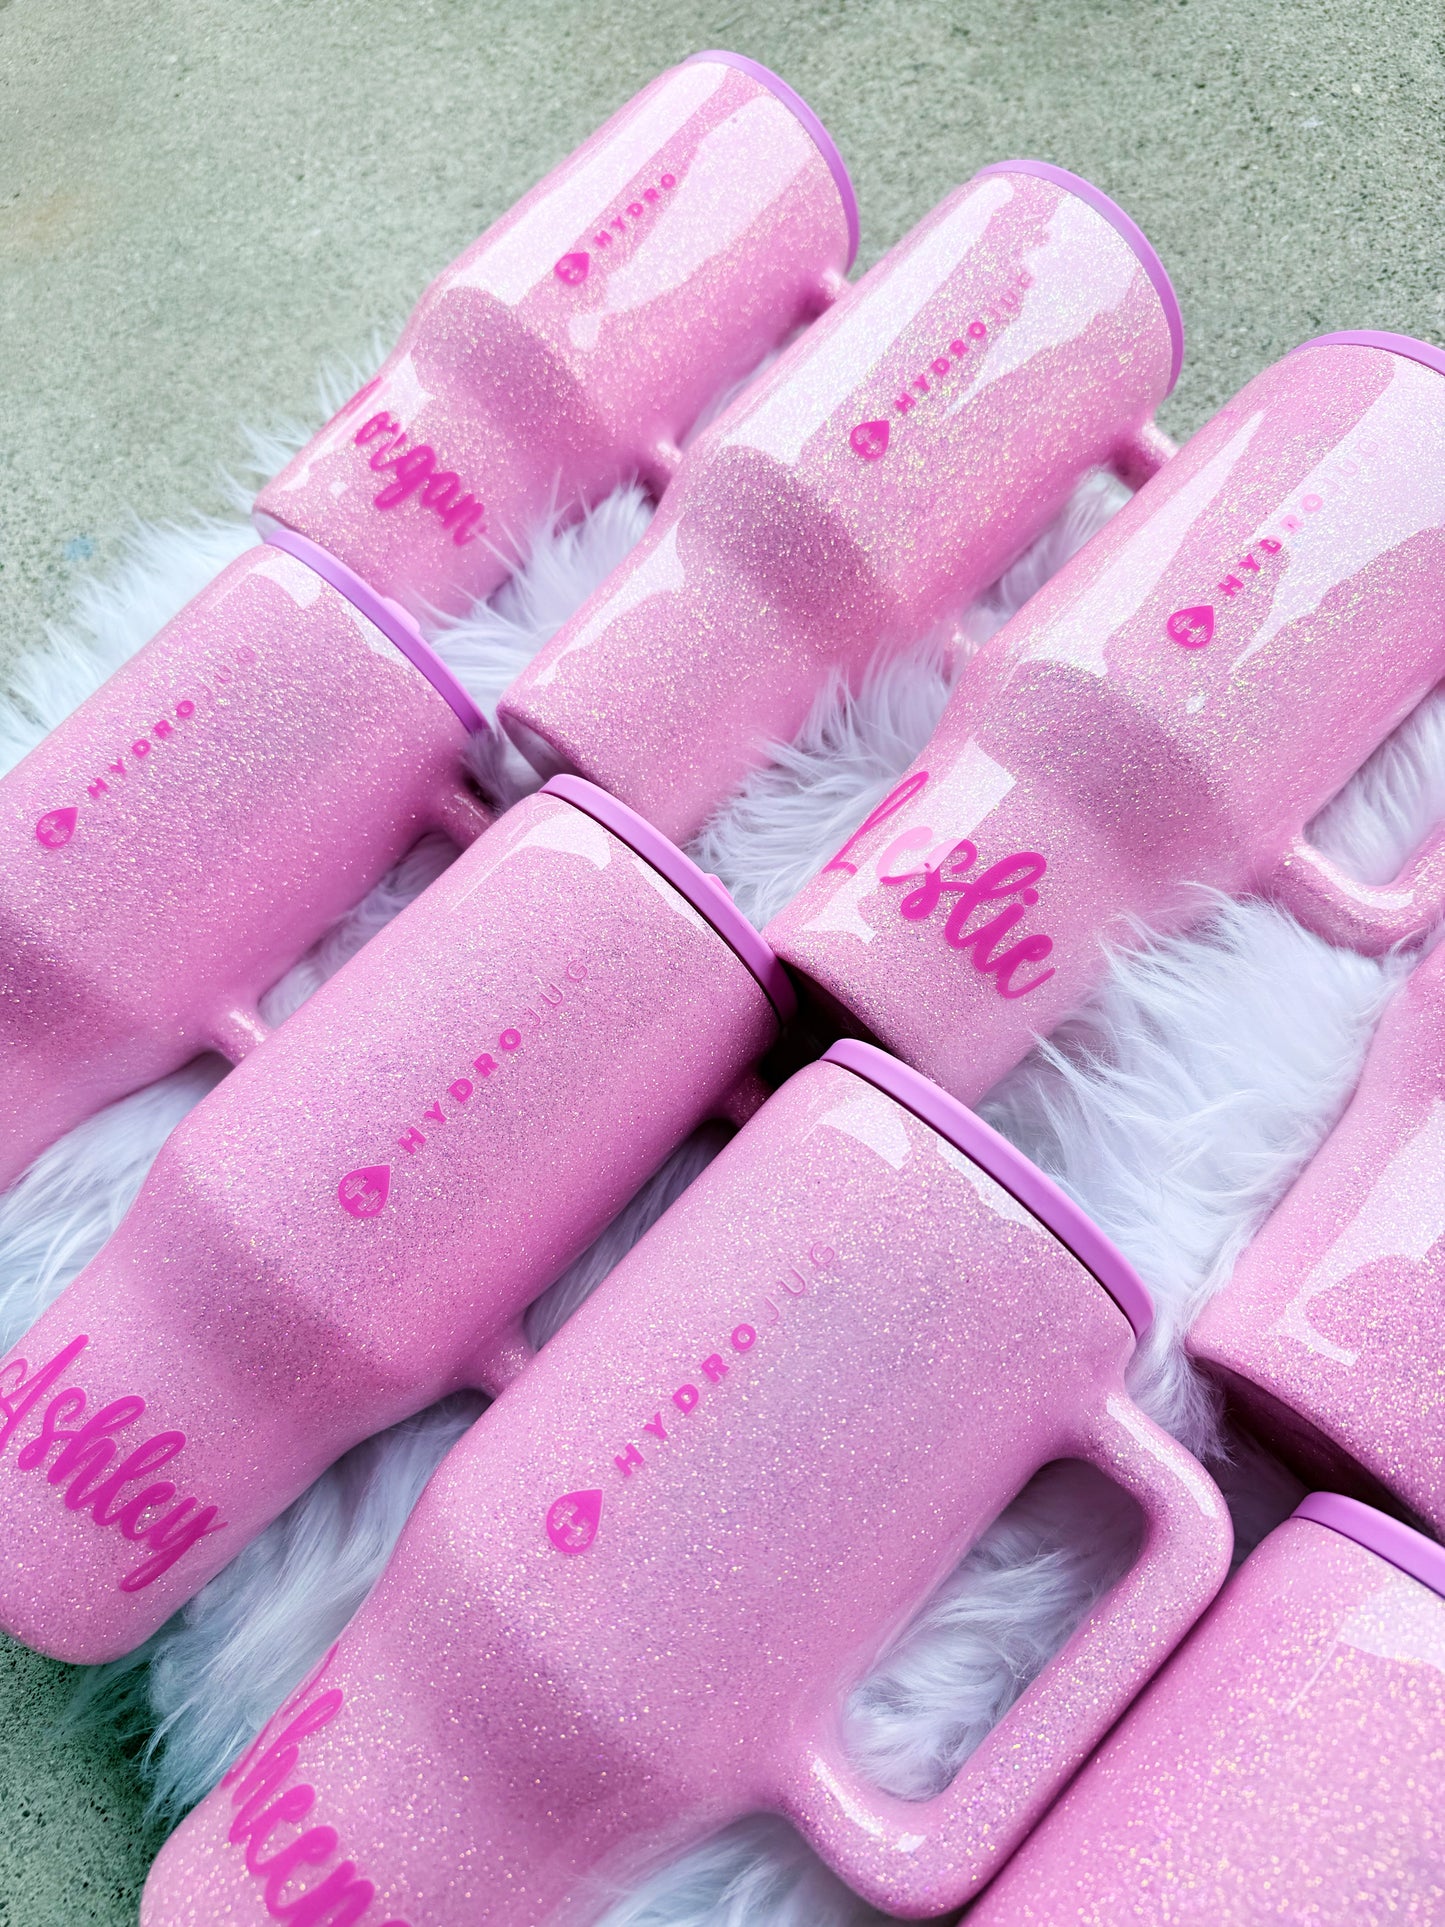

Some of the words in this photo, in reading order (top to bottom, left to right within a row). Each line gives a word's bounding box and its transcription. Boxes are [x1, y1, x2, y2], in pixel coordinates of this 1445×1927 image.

[821, 771, 1056, 999] Leslie
[400, 960, 588, 1154] HYDROJUG
[614, 1241, 835, 1477] HYDROJUG
